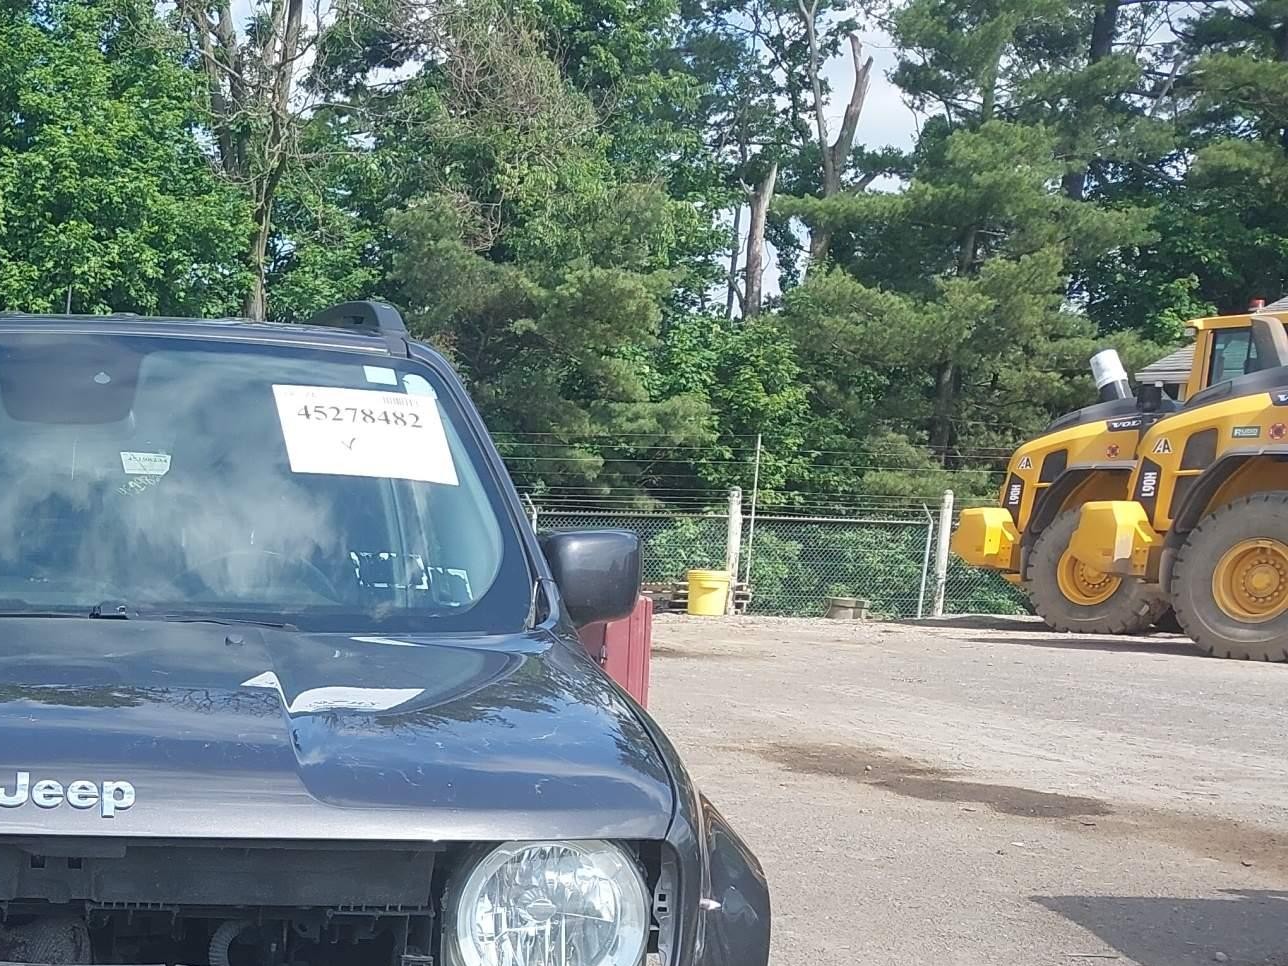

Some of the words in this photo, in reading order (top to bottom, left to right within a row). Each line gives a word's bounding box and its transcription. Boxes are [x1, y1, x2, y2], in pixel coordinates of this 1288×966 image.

[297, 404, 423, 429] 45278482
[1008, 484, 1022, 505] L90H
[1141, 471, 1158, 497] L90H
